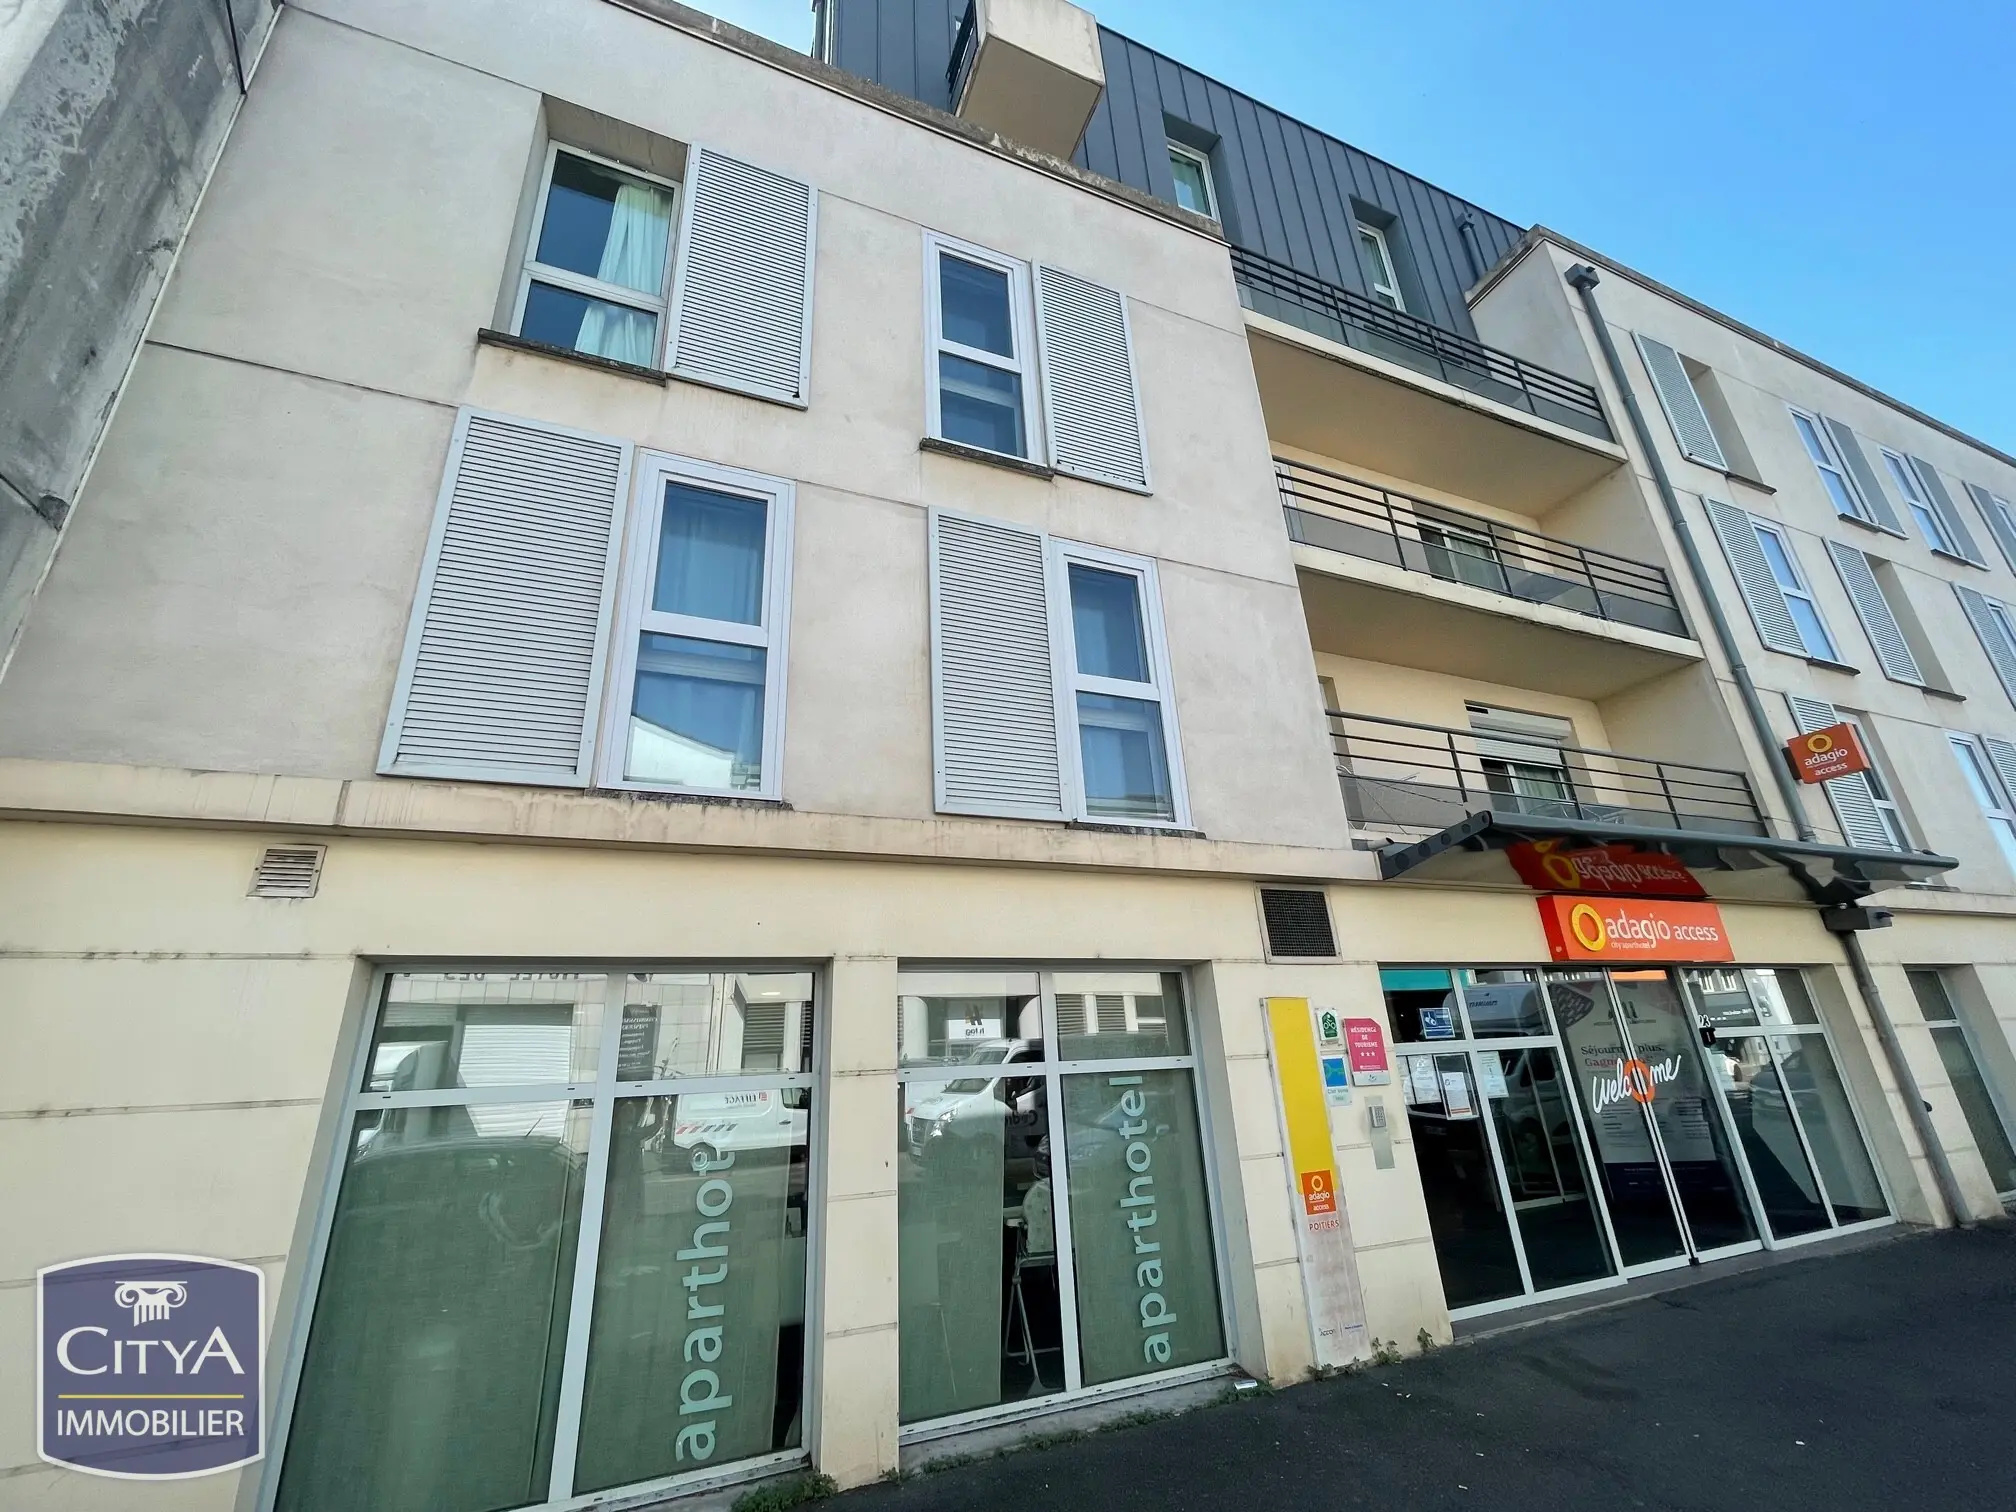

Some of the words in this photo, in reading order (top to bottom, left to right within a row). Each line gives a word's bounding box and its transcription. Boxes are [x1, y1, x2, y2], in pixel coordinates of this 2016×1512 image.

[1804, 747, 1848, 766] adagio
[1814, 761, 1848, 776] access
[1605, 908, 1671, 948] adagio
[1674, 925, 1719, 942] access
[1581, 1045, 1624, 1057] Séjourn
[1308, 1191, 1331, 1202] adagio
[1313, 1203, 1329, 1211] access
[1108, 1075, 1178, 1365] aparthotel
[1309, 1219, 1340, 1232] POITIERS
